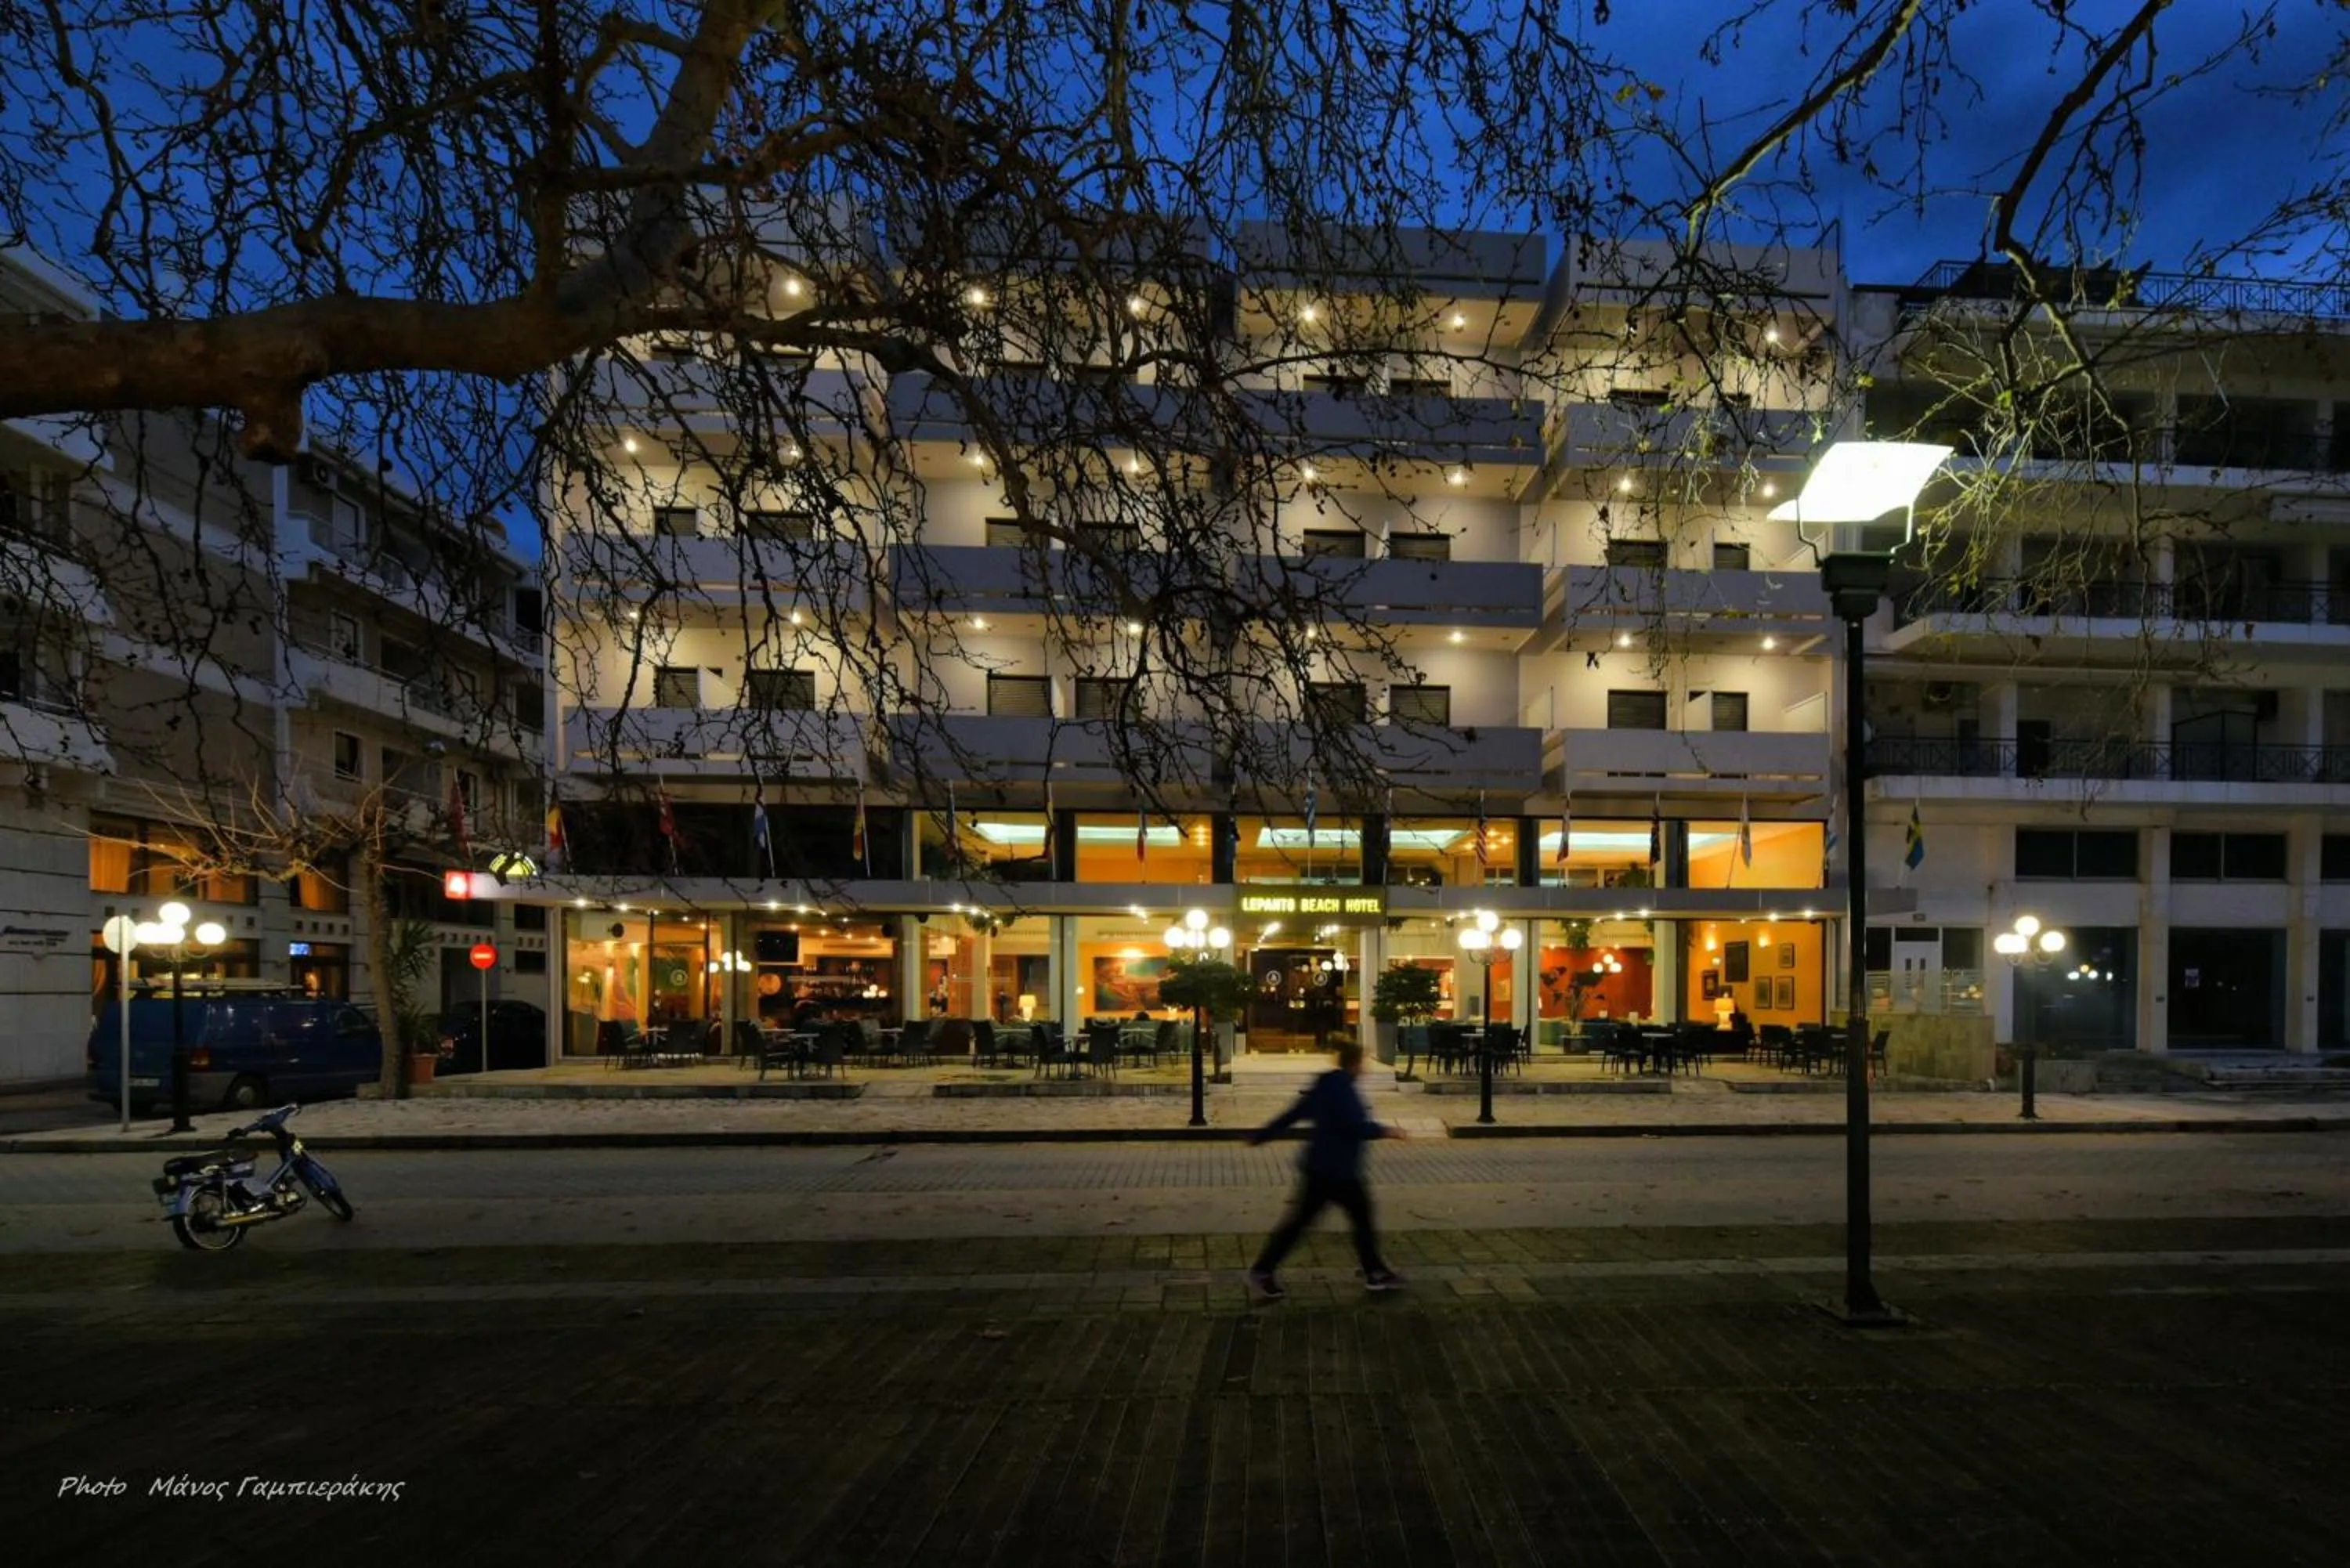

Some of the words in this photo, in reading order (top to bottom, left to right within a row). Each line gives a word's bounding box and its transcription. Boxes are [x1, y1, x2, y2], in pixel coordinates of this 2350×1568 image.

[1242, 897, 1295, 912] LEPANTO
[1300, 898, 1340, 912] BEACH
[1345, 898, 1381, 913] HOTEL
